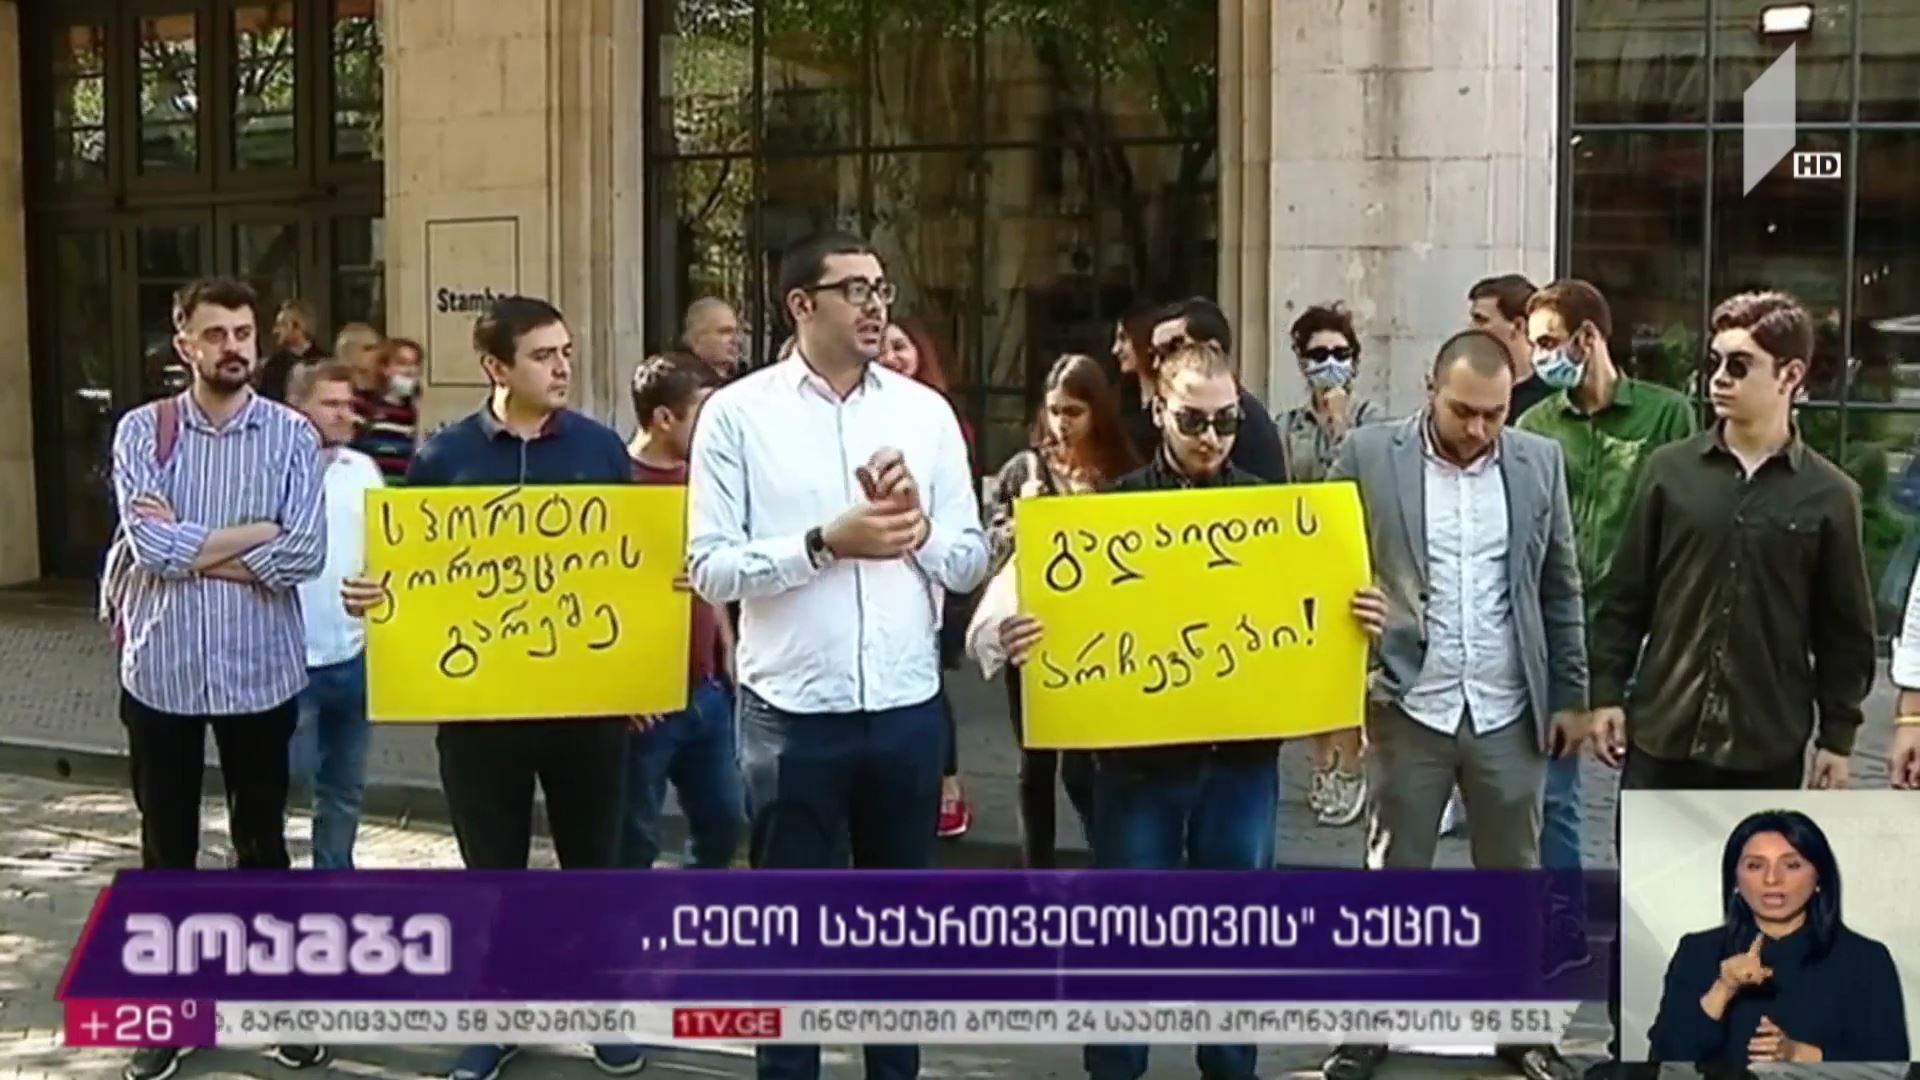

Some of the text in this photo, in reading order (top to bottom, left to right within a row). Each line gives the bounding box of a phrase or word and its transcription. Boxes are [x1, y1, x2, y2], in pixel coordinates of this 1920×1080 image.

[381, 486, 608, 546] სპორტი
[1045, 496, 1318, 592] გადაიდოს
[439, 592, 621, 678] გარეშე
[1042, 598, 1315, 694] არჩევნები!
